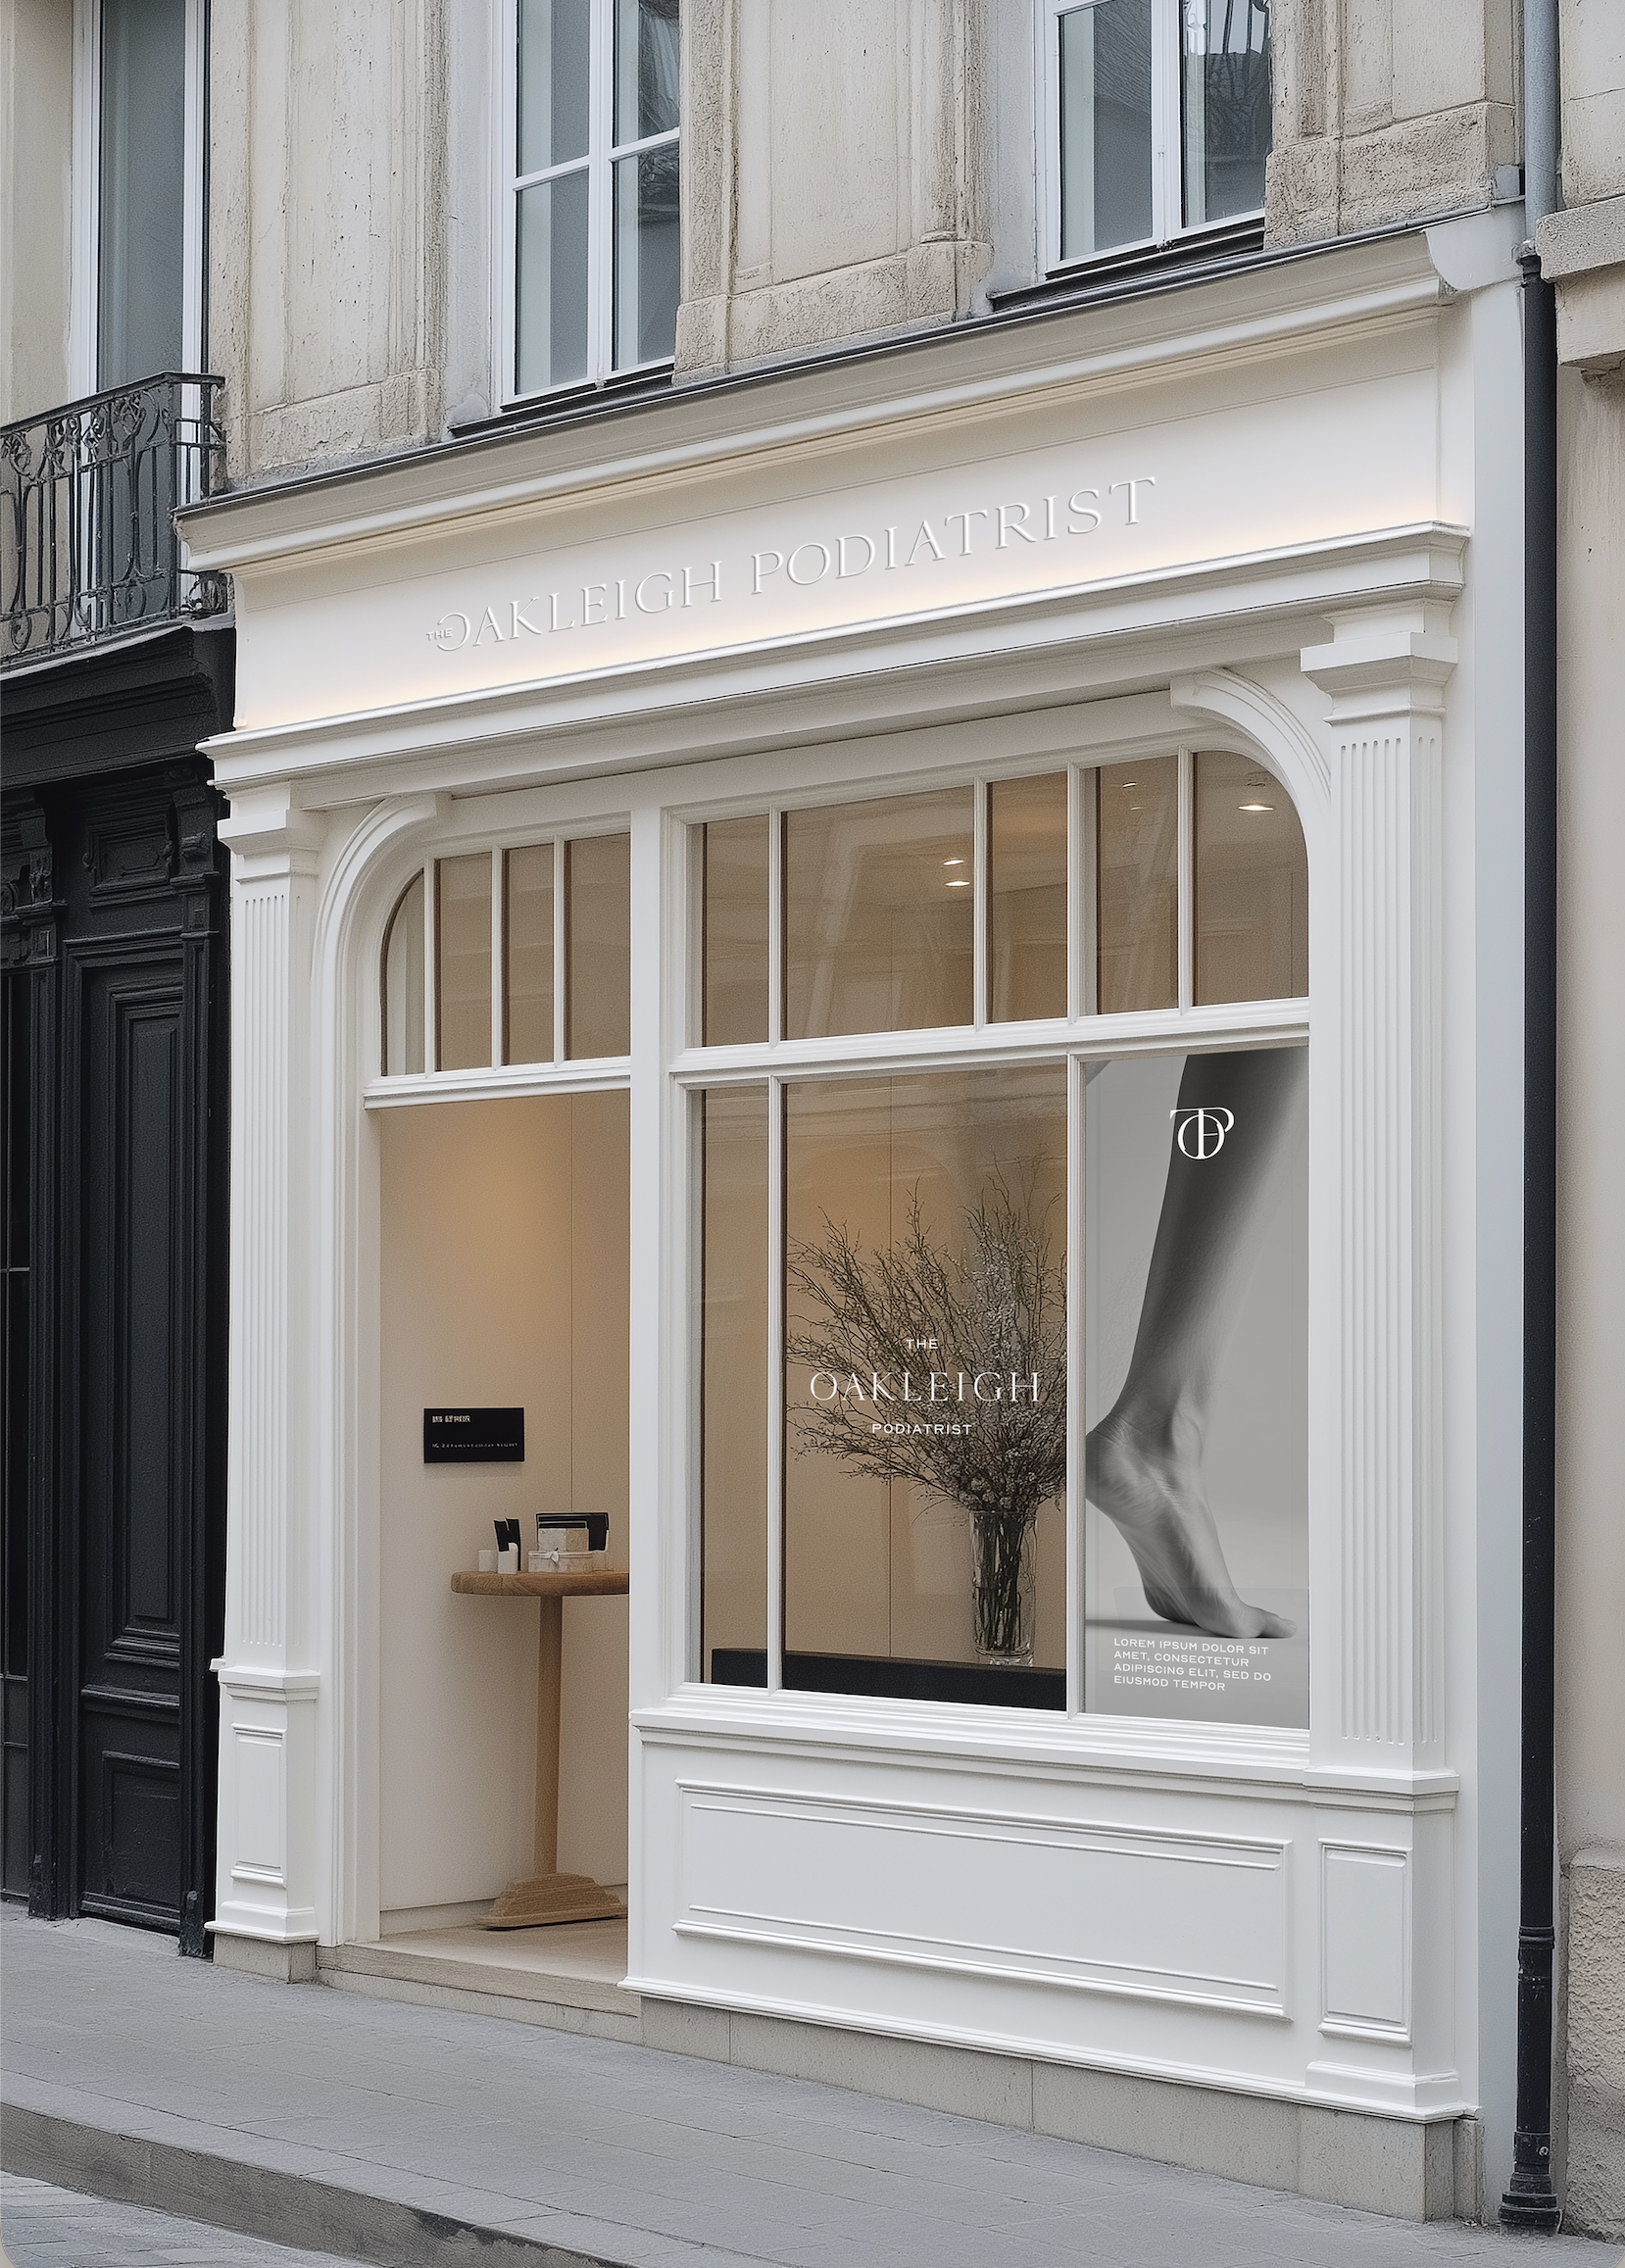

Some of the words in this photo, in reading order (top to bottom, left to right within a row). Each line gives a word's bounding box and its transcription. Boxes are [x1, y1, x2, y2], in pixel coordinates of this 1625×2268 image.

[751, 476, 1157, 596] PODIATRIST
[437, 561, 722, 652] OAKLEIGH
[425, 628, 453, 642] THE
[906, 1339, 939, 1350] THE
[811, 1371, 1039, 1402] OAKLEIGH
[871, 1423, 972, 1435] PODIATRIST
[1113, 1638, 1156, 1649] LOREM
[1159, 1641, 1198, 1652] IPSUM
[1202, 1643, 1245, 1654] DOLOR
[1249, 1646, 1269, 1655] SIT
[1113, 1651, 1151, 1662] AMET,
[1155, 1652, 1250, 1667] CONSECTETUR
[1113, 1663, 1185, 1675] ADIPISCING
[1189, 1667, 1219, 1679] ELIT,
[1223, 1670, 1250, 1680] SED
[1254, 1672, 1272, 1682] DO
[1113, 1675, 1169, 1687] EIUSMOD
[1173, 1679, 1226, 1691] TEMPOR
